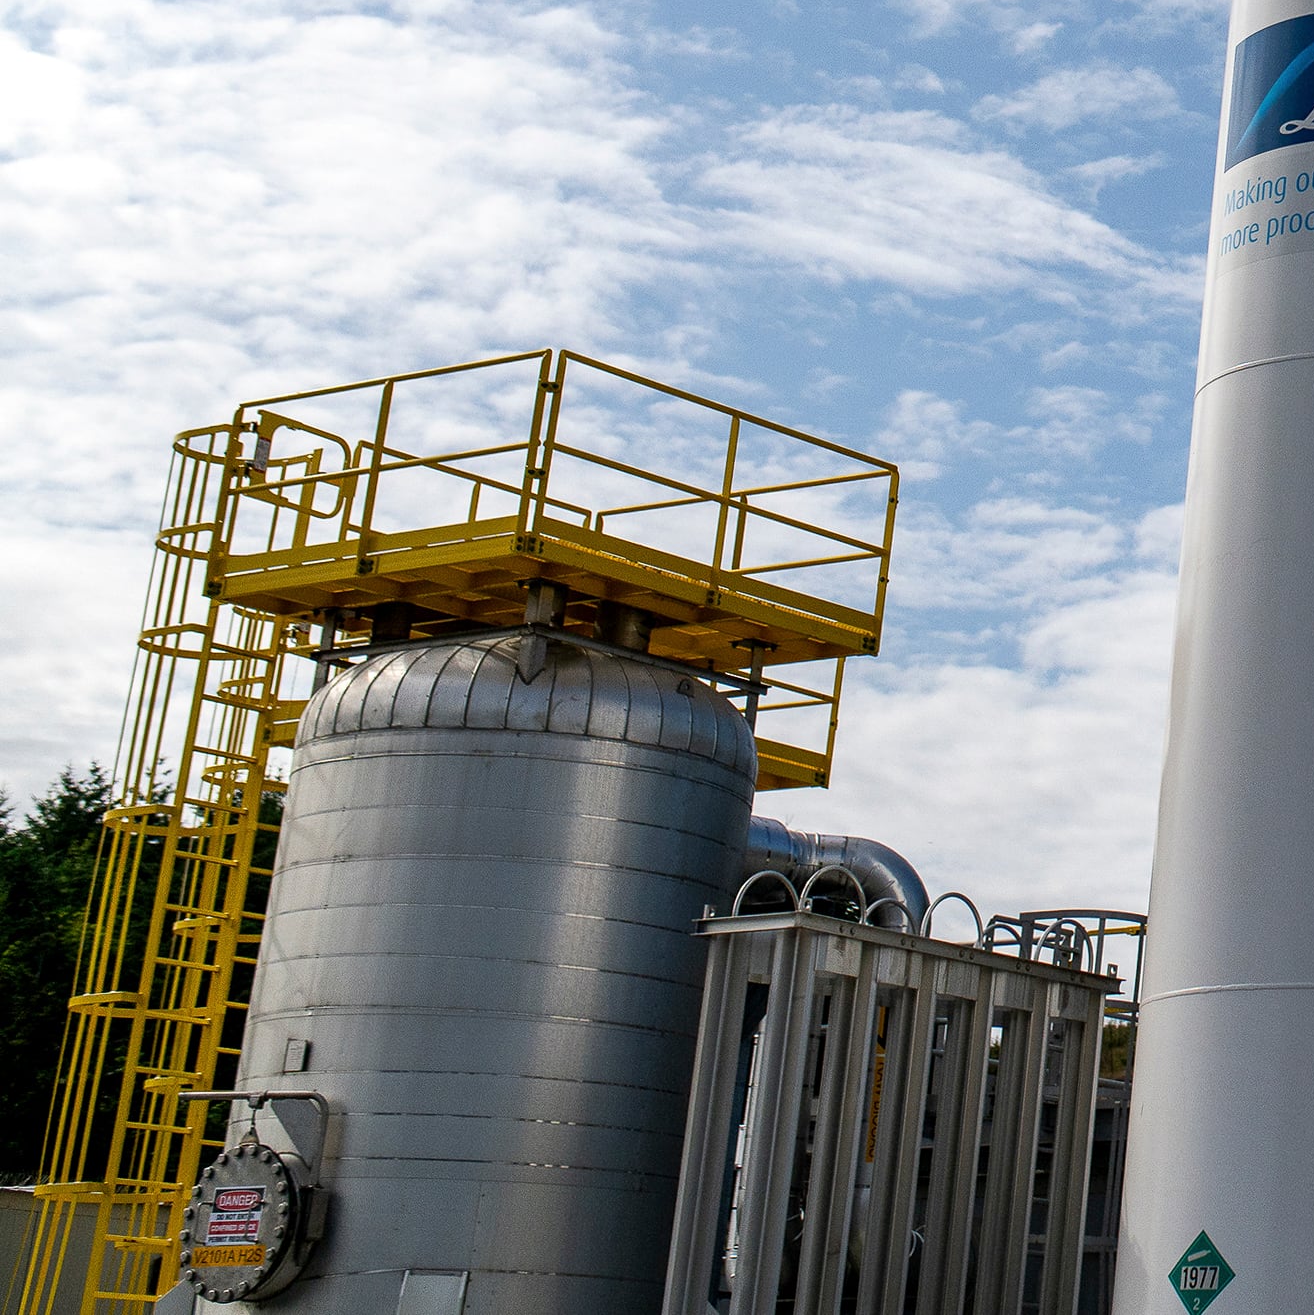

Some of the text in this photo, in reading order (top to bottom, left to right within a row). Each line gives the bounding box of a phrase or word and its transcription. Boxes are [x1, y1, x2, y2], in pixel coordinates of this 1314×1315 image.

[1224, 176, 1287, 217] Making
[1220, 222, 1260, 257] more
[194, 1247, 263, 1264] V2101A H2S
[1183, 1267, 1218, 1289] 1977
[1192, 1297, 1201, 1311] 2
